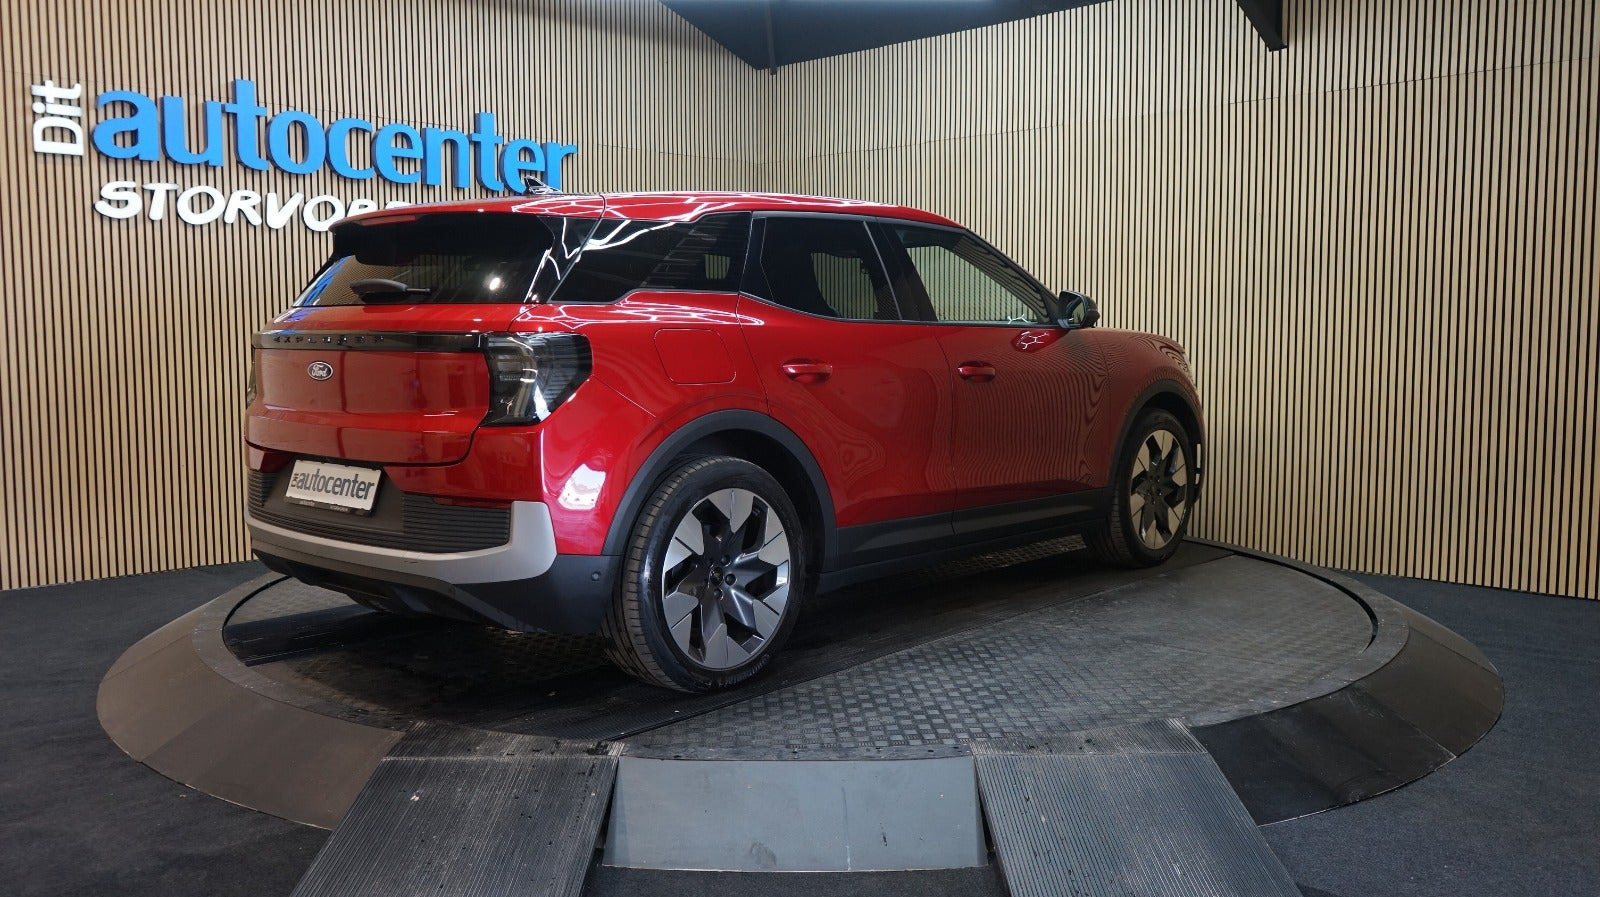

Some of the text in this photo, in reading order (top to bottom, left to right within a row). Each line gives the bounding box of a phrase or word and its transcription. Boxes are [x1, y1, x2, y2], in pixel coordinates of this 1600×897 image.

[31, 79, 577, 193] Dit autocenter
[94, 180, 412, 232] STORVO
[296, 468, 375, 500] autocenter
